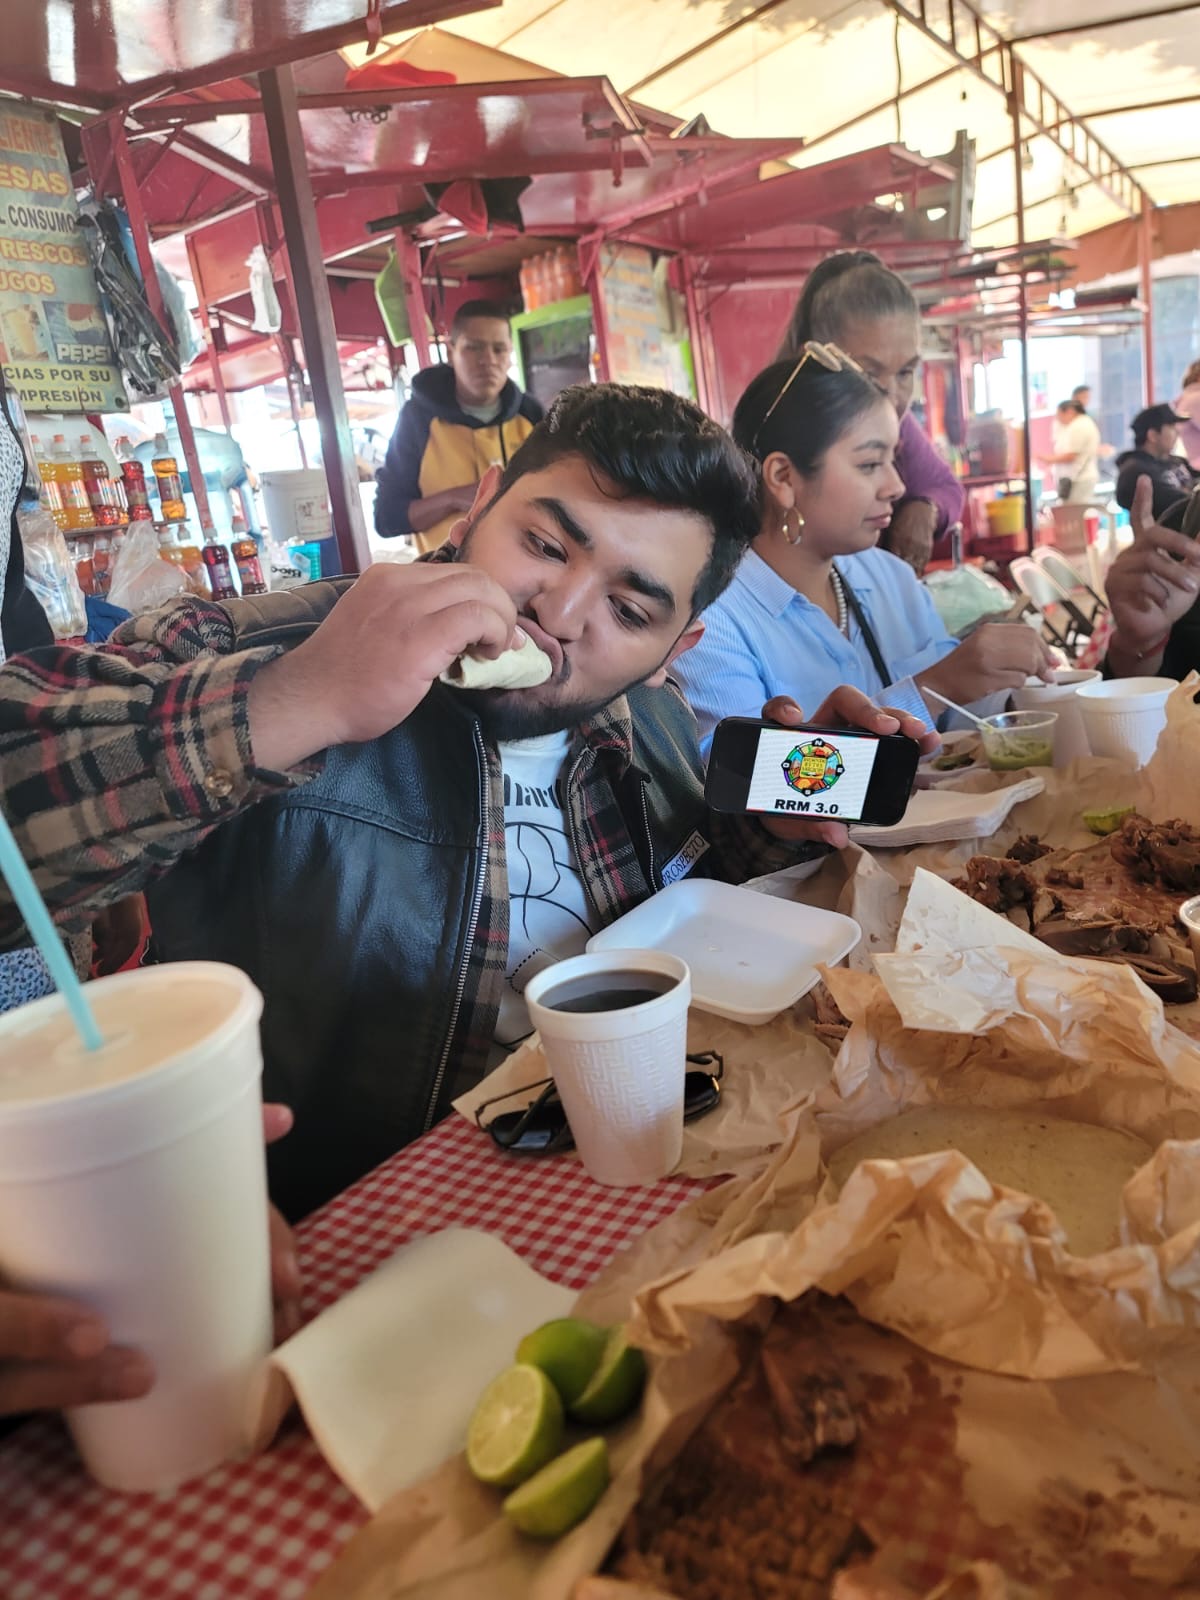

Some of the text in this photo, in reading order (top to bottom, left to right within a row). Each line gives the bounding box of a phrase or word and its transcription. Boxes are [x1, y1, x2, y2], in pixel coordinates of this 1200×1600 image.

[8, 204, 76, 232] CONSUMO
[49, 368, 86, 382] POR
[89, 370, 111, 382] SU
[774, 798, 839, 815] RRM 3.0
[662, 834, 705, 887] PROSPECTO
